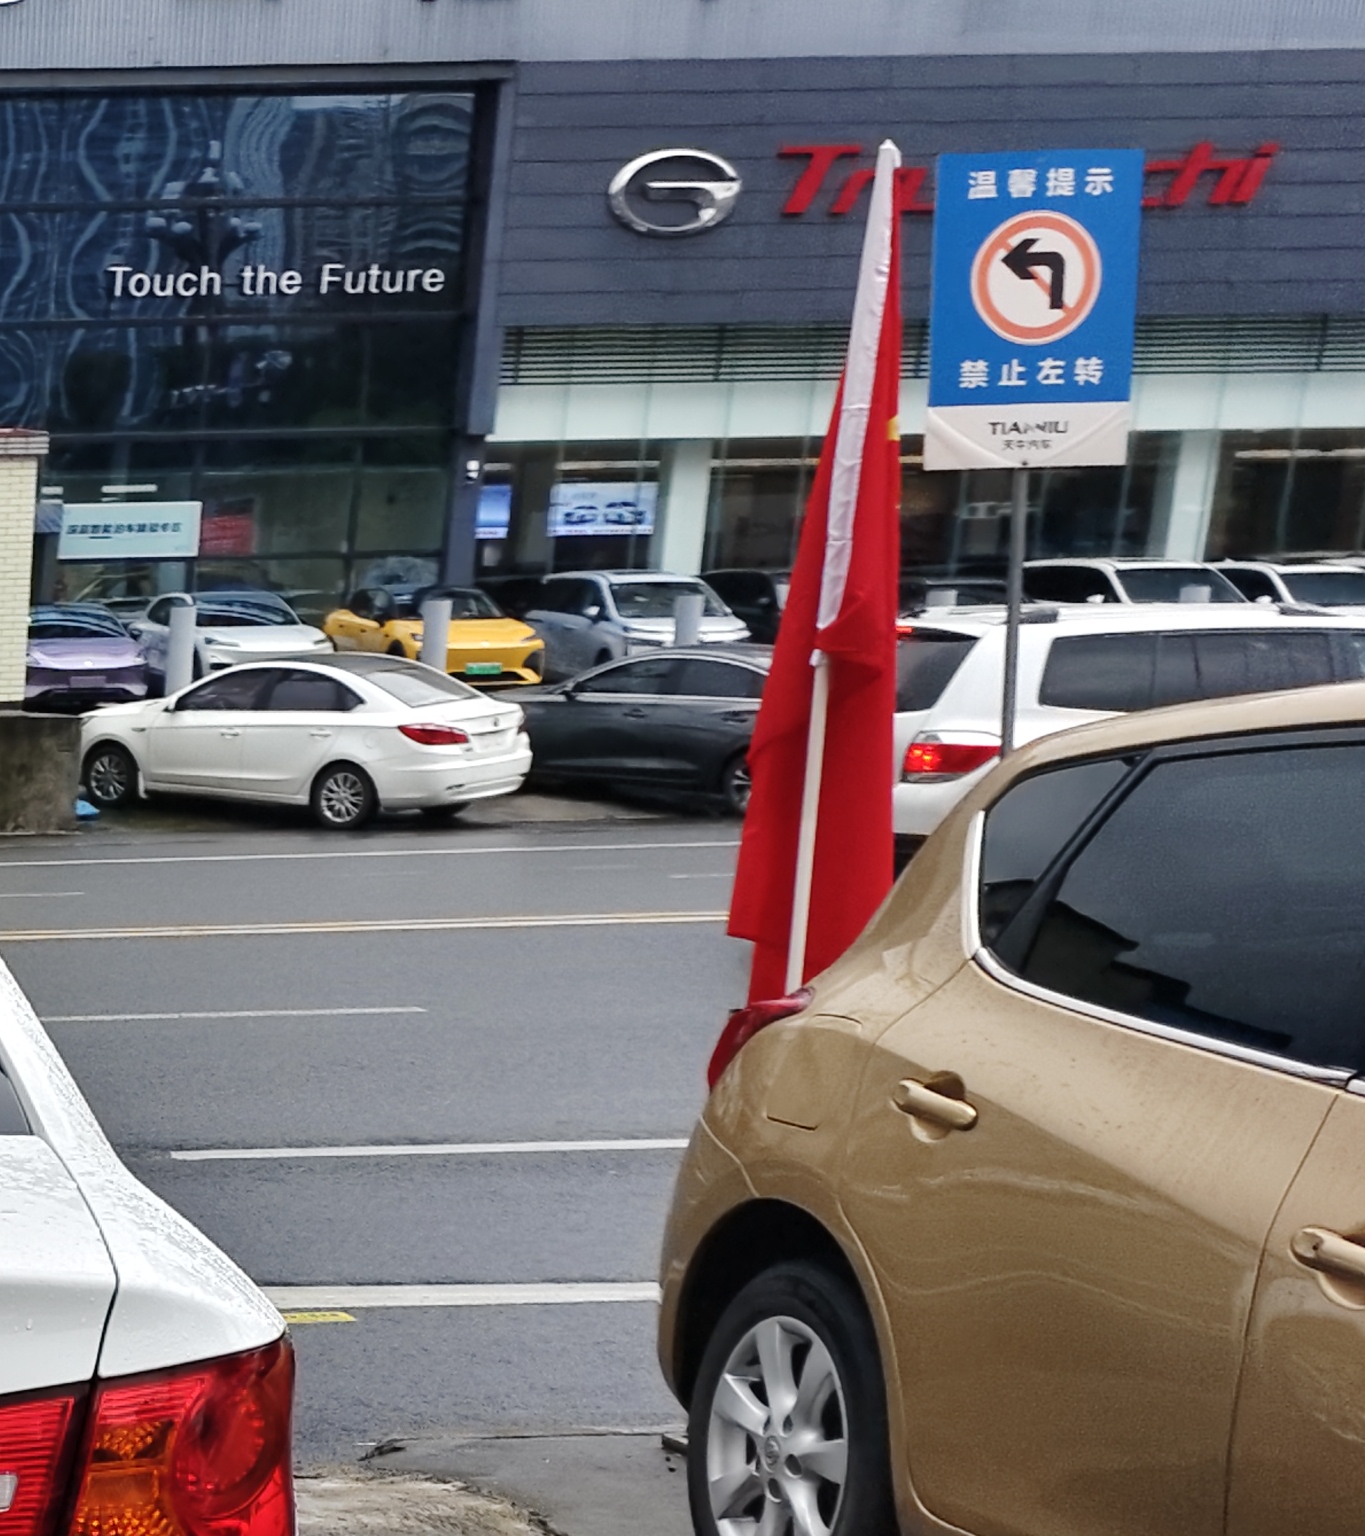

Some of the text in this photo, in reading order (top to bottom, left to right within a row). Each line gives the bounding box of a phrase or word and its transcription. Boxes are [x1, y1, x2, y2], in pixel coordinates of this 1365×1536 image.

[968, 167, 1114, 200] 温馨提示
[106, 262, 446, 298] Touch the Future
[958, 356, 1105, 389] 禁止左转
